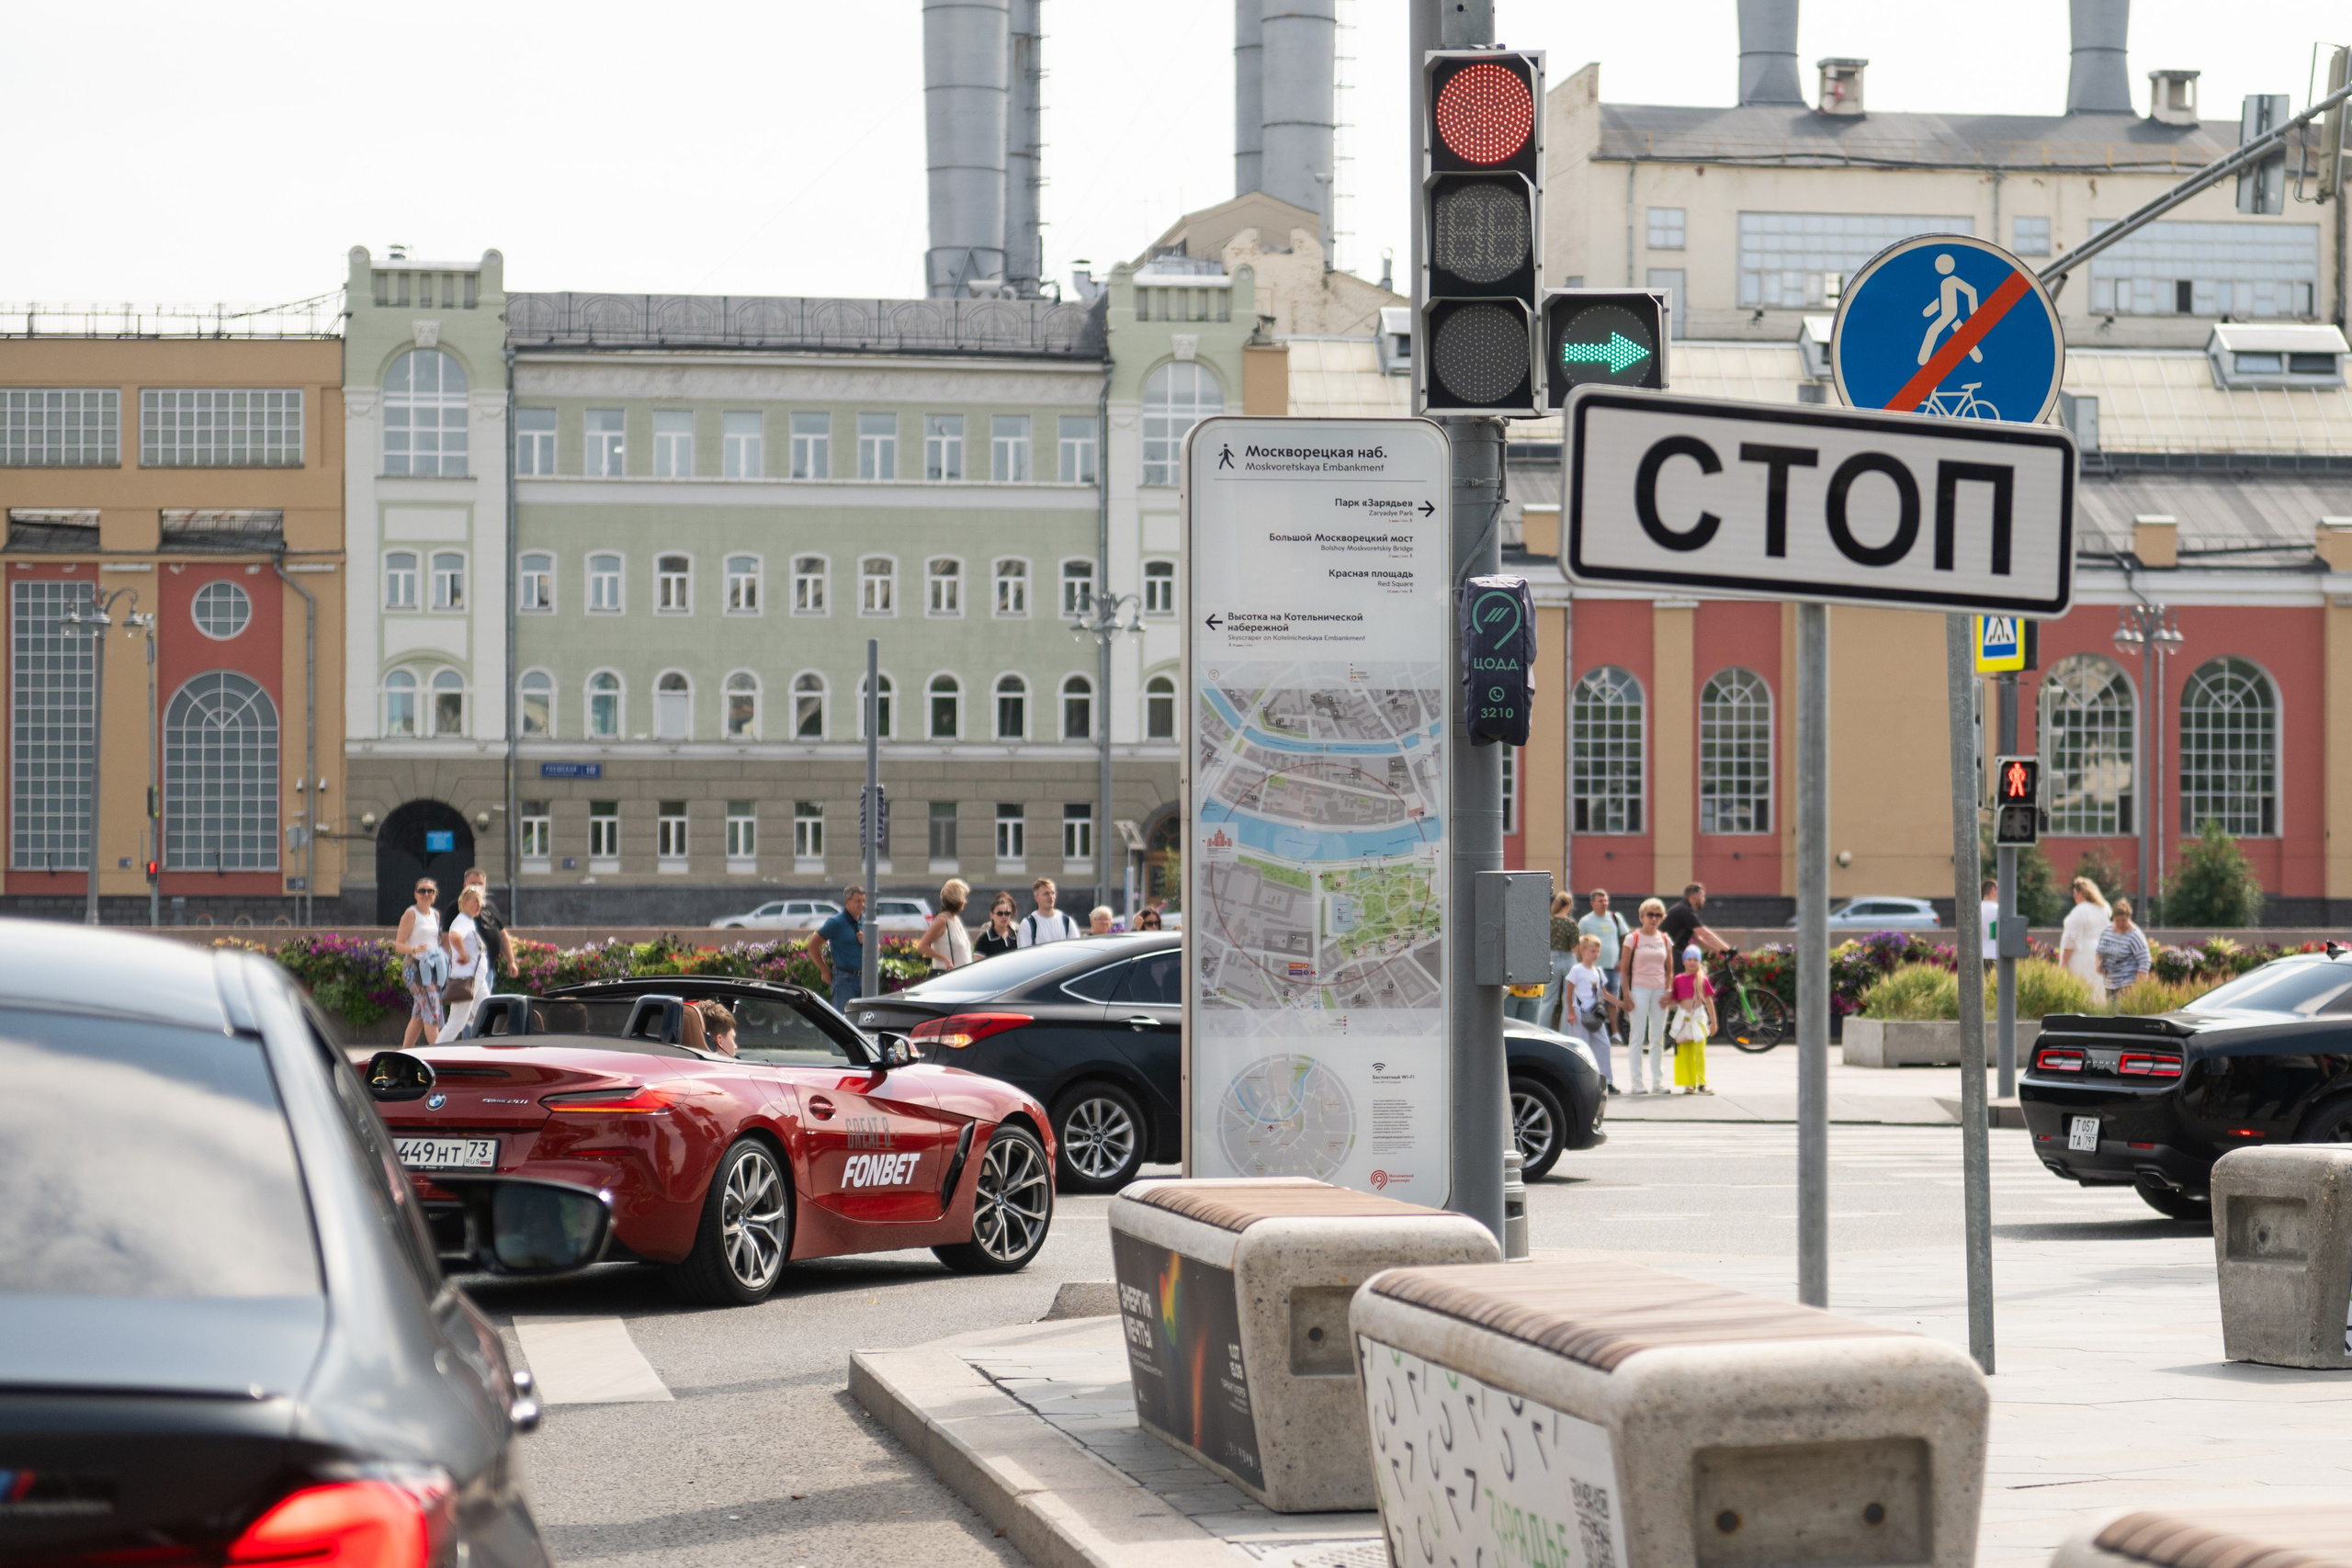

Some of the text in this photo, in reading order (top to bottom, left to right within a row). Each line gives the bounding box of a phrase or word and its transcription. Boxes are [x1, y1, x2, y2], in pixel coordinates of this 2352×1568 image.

[1245, 445, 1387, 460] Москворецкая наб.
[1245, 462, 1385, 473] Moskvoretskaya Embankment
[1335, 498, 1413, 508] Парк «Зарядье»
[1634, 434, 2015, 576] СТОП
[1269, 533, 1312, 542] Большой
[1315, 533, 1388, 544] Москворецкий
[1393, 545, 1413, 553] Bridge
[1329, 569, 1414, 579] Красная площадь
[1227, 612, 1268, 621] Высотка
[1283, 613, 1363, 622] Котельнической
[1227, 623, 1289, 633] набережной
[1474, 657, 1520, 671] ЦОДД
[1480, 707, 1514, 718] 3210
[845, 1116, 879, 1149] GREAT
[881, 1116, 892, 1148] 8
[2085, 1135, 2095, 1146] 797
[469, 1142, 488, 1157] 73
[841, 1153, 921, 1189] FONBET
[1120, 1282, 1153, 1320] ЭНЕРГИЯ
[1124, 1314, 1153, 1349] МЕЧТЫ
